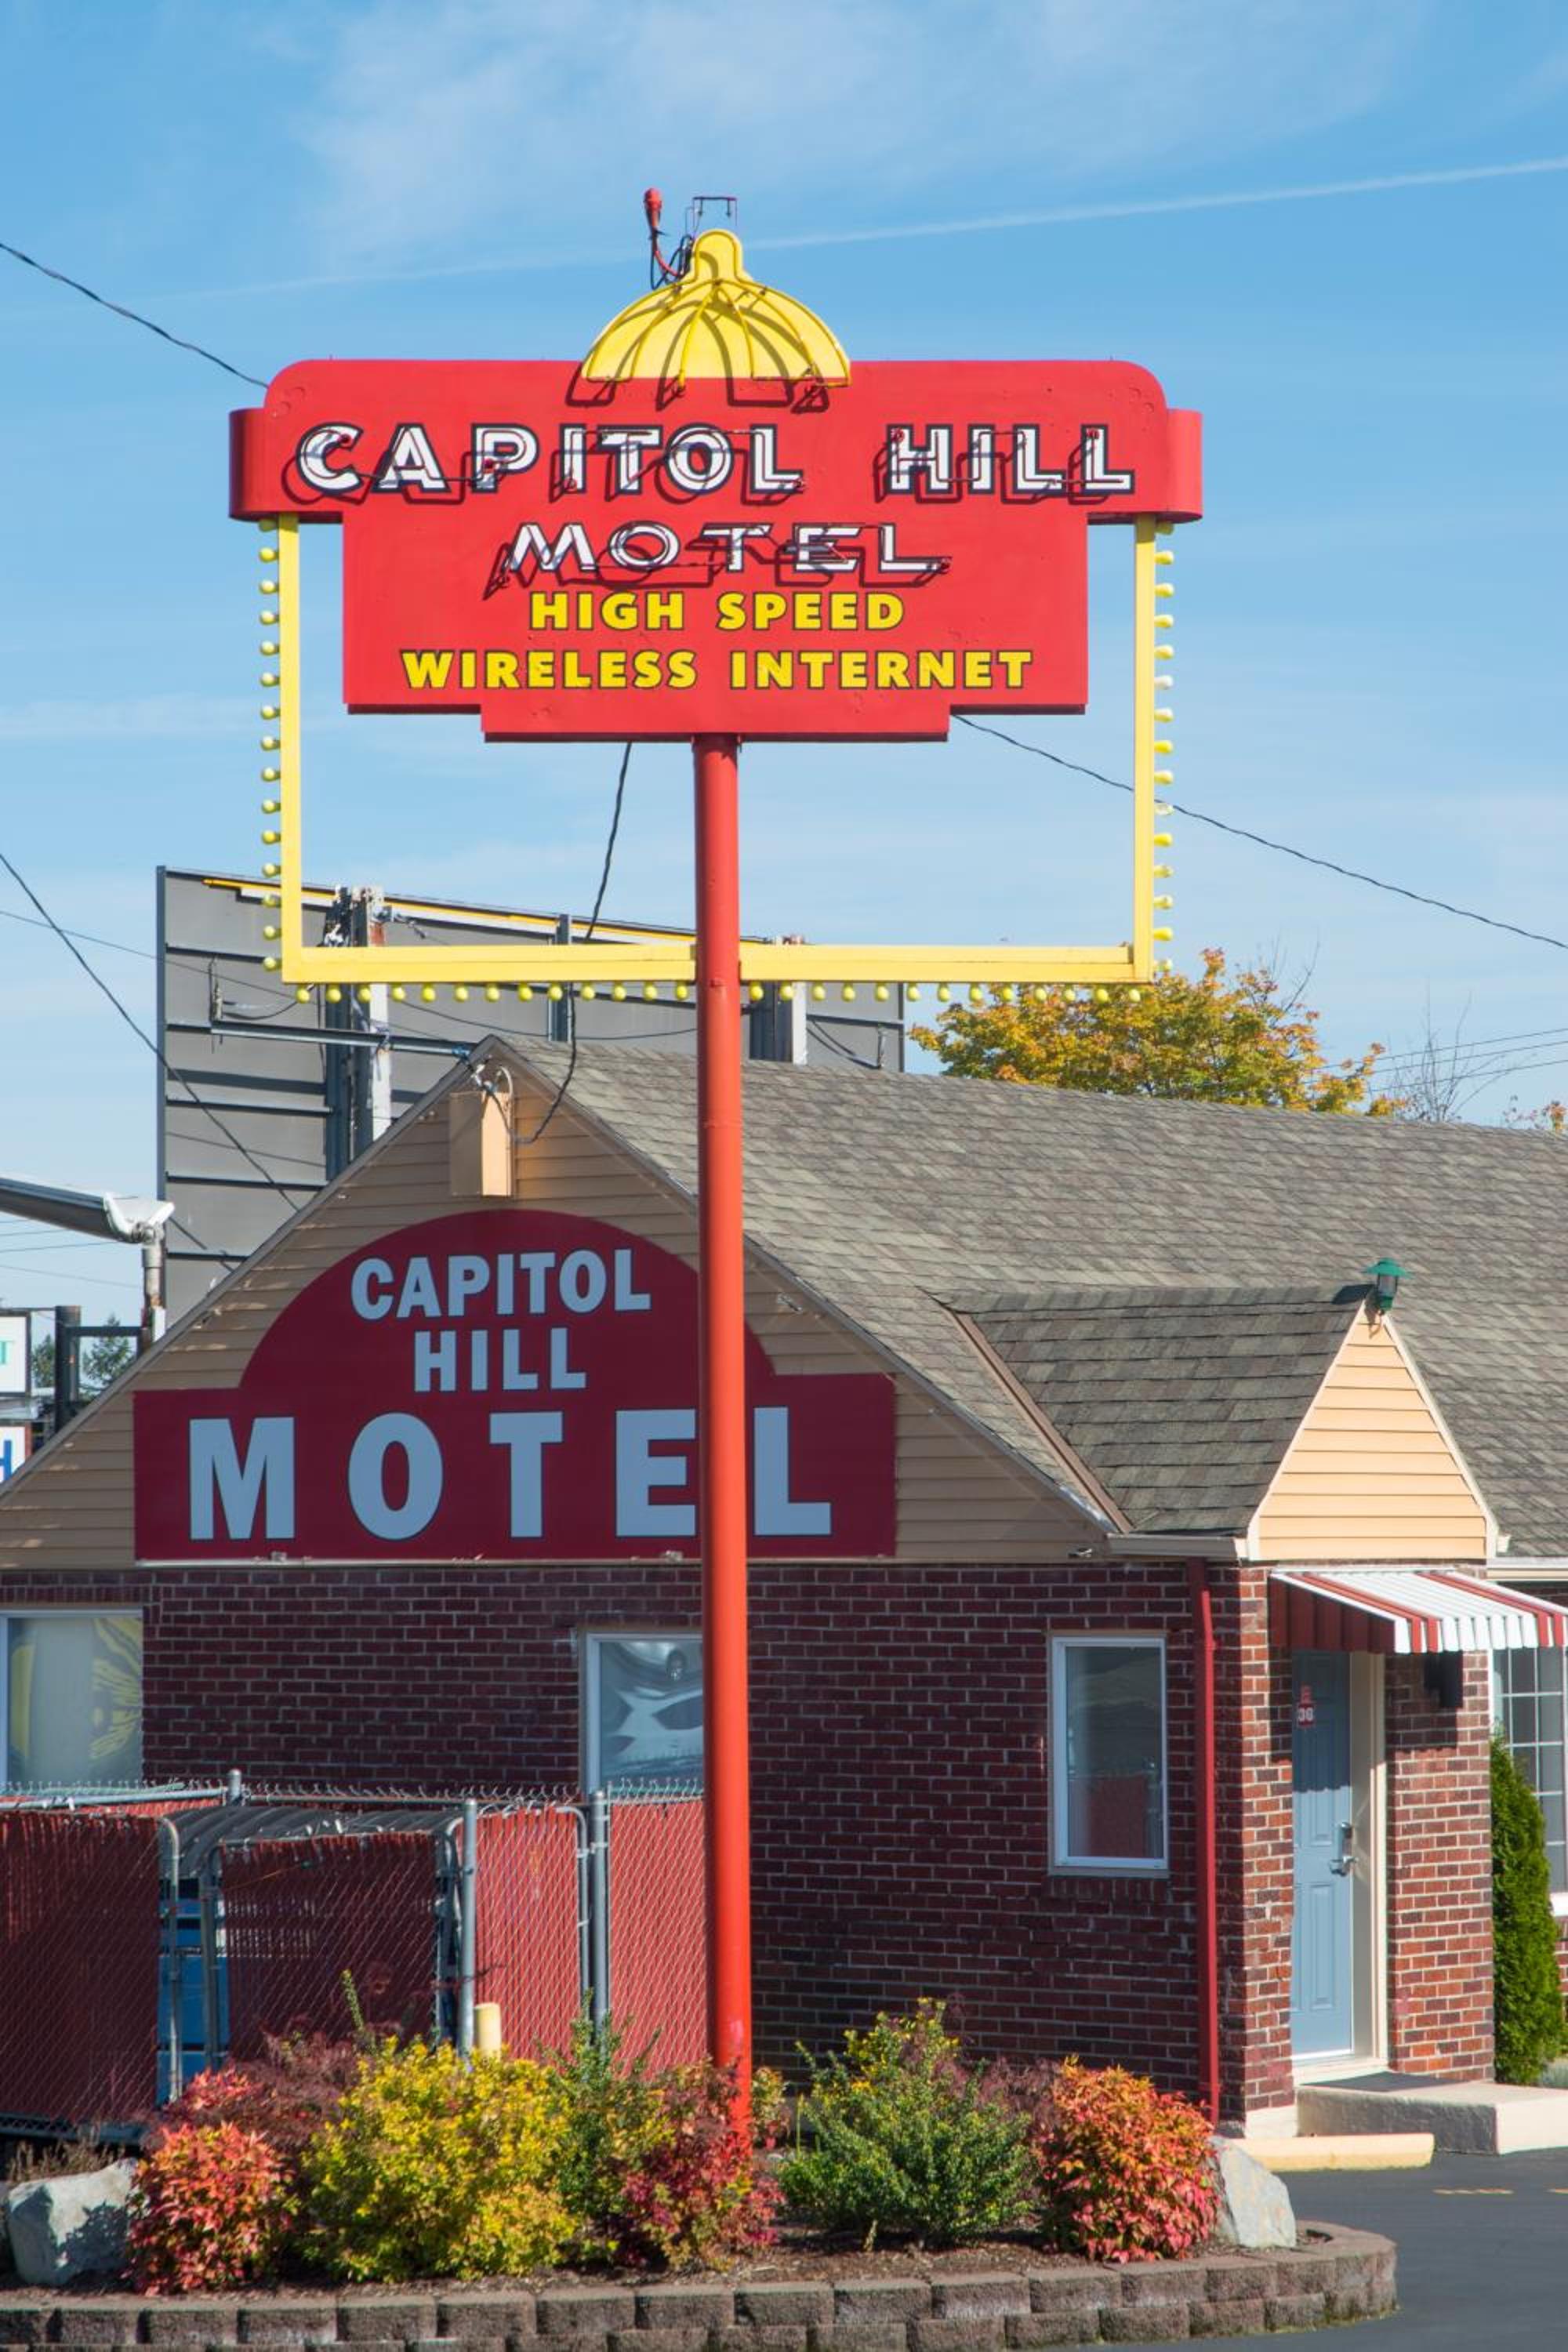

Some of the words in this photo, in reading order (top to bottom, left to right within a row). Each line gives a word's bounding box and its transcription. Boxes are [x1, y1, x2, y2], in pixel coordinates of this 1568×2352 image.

[296, 423, 804, 493] CAPITOL
[887, 423, 1135, 494] HILL
[506, 521, 939, 573] MOTEL
[528, 590, 685, 630] HIGH
[717, 591, 905, 630] SPEED
[401, 649, 698, 689] WIRELESS
[729, 649, 1033, 689] INTERNET
[350, 1249, 652, 1320] CAPITOL
[414, 1327, 586, 1392] HILL
[189, 1406, 832, 1540] MOTEL
